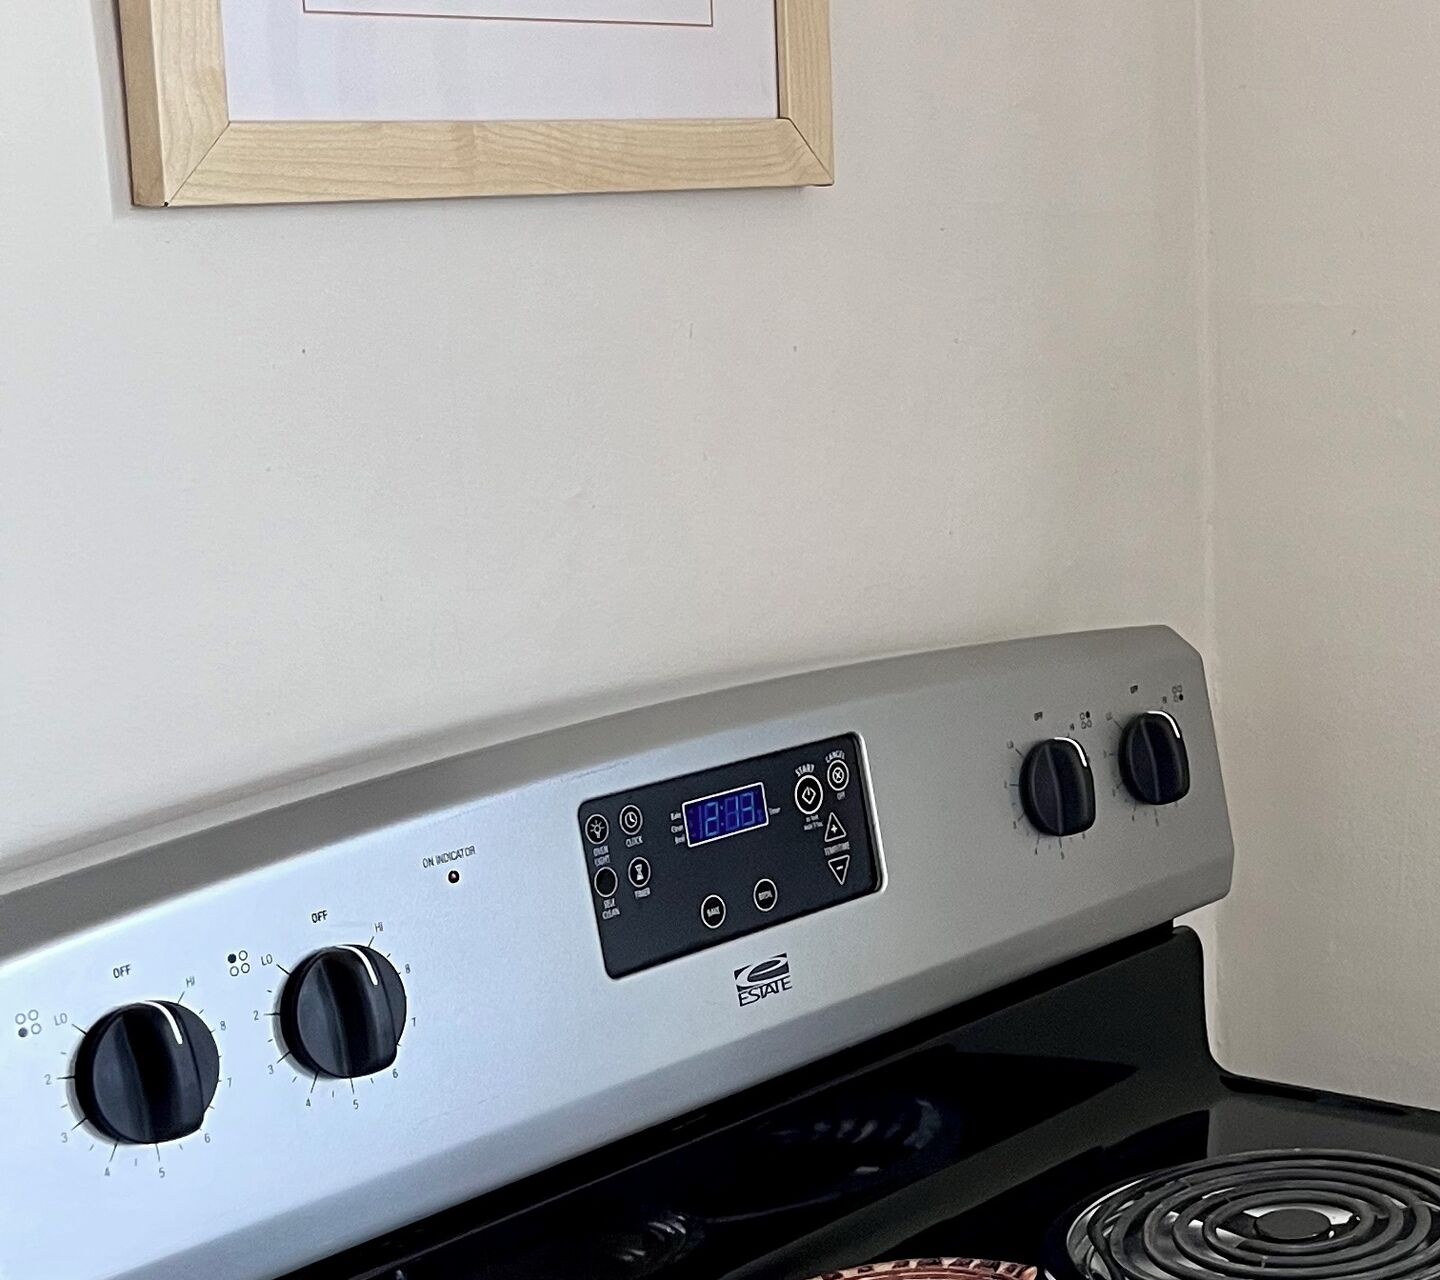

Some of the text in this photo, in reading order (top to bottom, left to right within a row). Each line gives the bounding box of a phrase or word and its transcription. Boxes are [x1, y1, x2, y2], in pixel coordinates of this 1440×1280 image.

[825, 750, 845, 764] CANCEL
[794, 763, 815, 777] START
[625, 835, 643, 848] CLOCK
[422, 845, 476, 869] ON INDICATOR
[311, 910, 328, 924] OFF
[601, 907, 620, 920] CLEAN
[374, 923, 384, 933] HI
[261, 953, 273, 966] LO
[112, 964, 131, 979] OFF
[405, 963, 411, 974] 8
[185, 976, 196, 988] HI
[737, 974, 793, 1007] ESTATE
[54, 1012, 68, 1026] LO
[253, 1010, 259, 1021] 2
[219, 1020, 227, 1031] 8
[267, 1064, 274, 1074] 3
[392, 1068, 399, 1078] 6
[44, 1073, 52, 1085] 2
[305, 1098, 312, 1107] 4
[353, 1099, 359, 1110] 5
[61, 1132, 68, 1144] 3
[204, 1133, 211, 1143] 6
[104, 1167, 111, 1177] 4
[159, 1167, 166, 1178] 5
